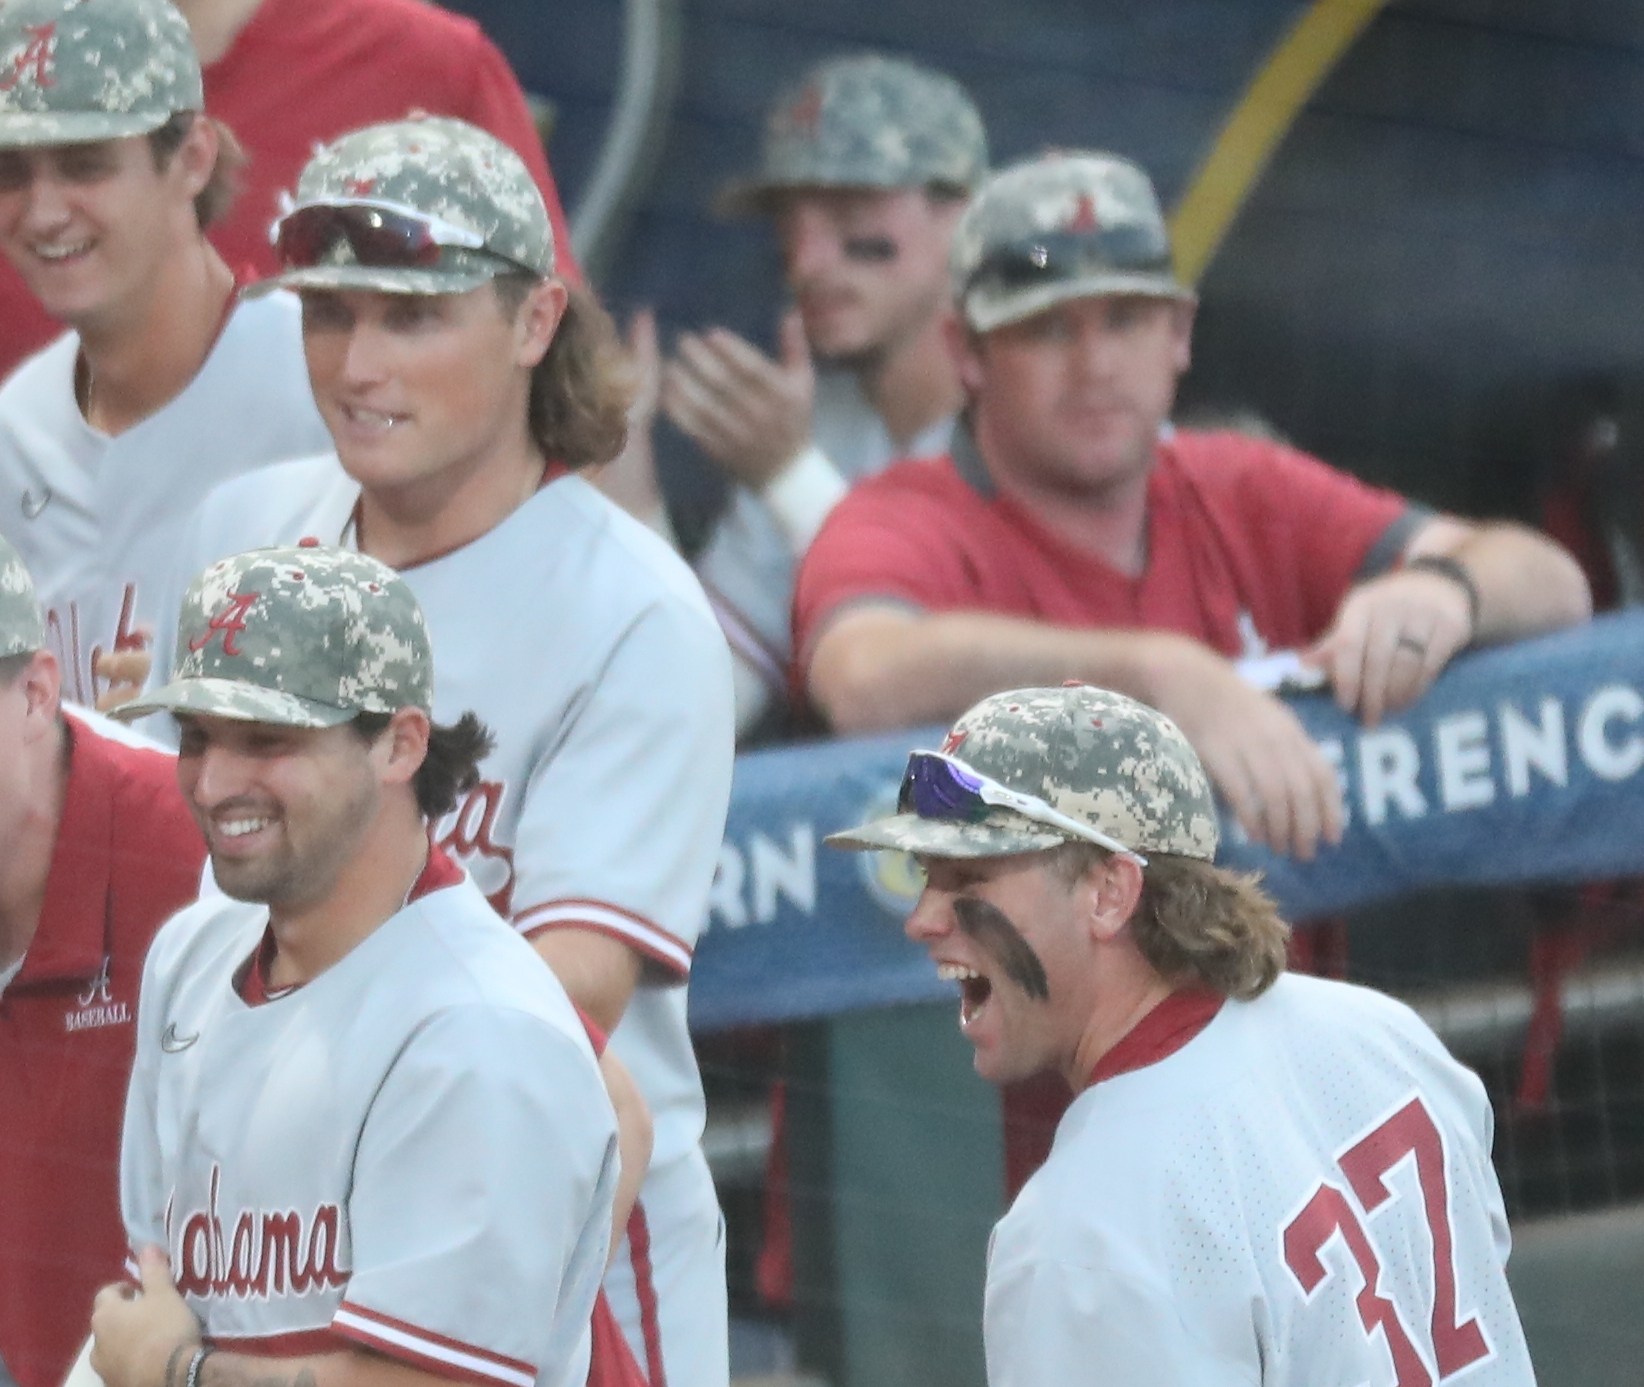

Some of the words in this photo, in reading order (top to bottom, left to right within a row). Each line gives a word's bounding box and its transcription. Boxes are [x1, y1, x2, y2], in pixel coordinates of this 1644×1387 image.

[190, 592, 260, 658] A
[1318, 684, 1644, 828] RENC
[78, 956, 113, 1006] A
[65, 1001, 131, 1031] BASEBALL
